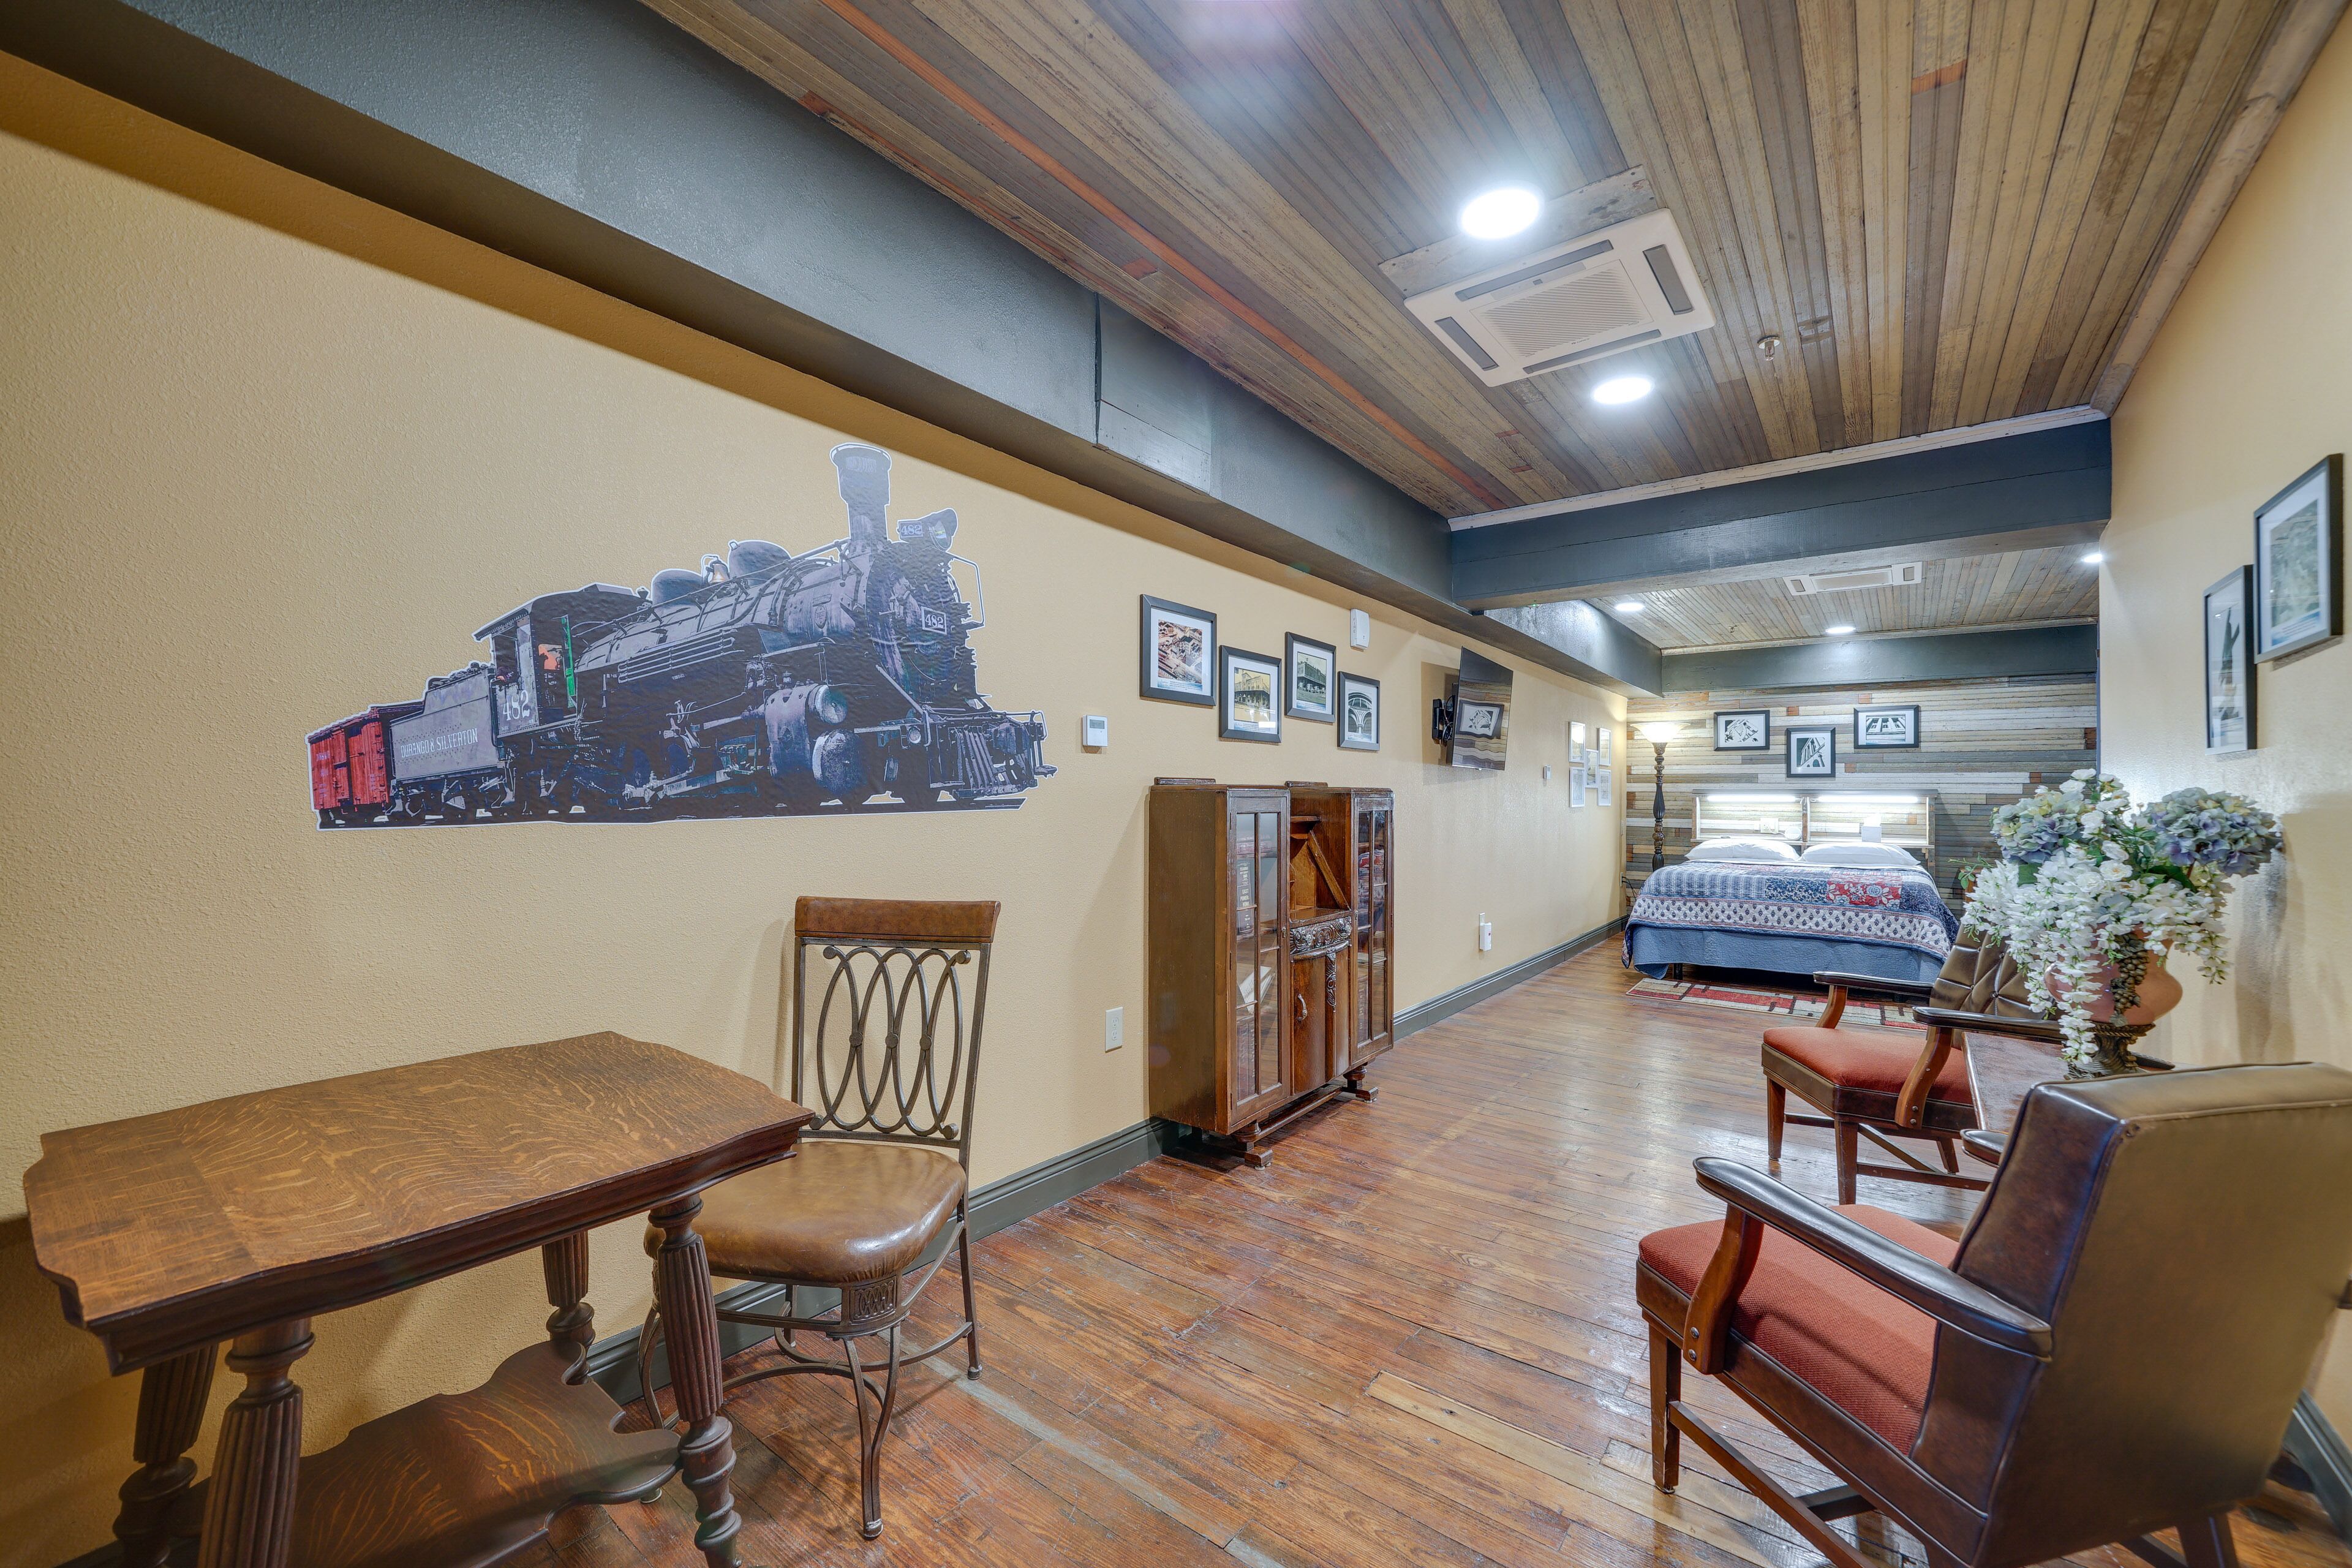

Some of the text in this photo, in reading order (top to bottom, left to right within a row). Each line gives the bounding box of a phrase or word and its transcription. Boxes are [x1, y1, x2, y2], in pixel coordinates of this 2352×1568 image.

[901, 524, 922, 535] 482
[925, 614, 944, 628] 482
[502, 690, 530, 722] 482
[401, 728, 478, 758] DURANGO & SILVERTON
